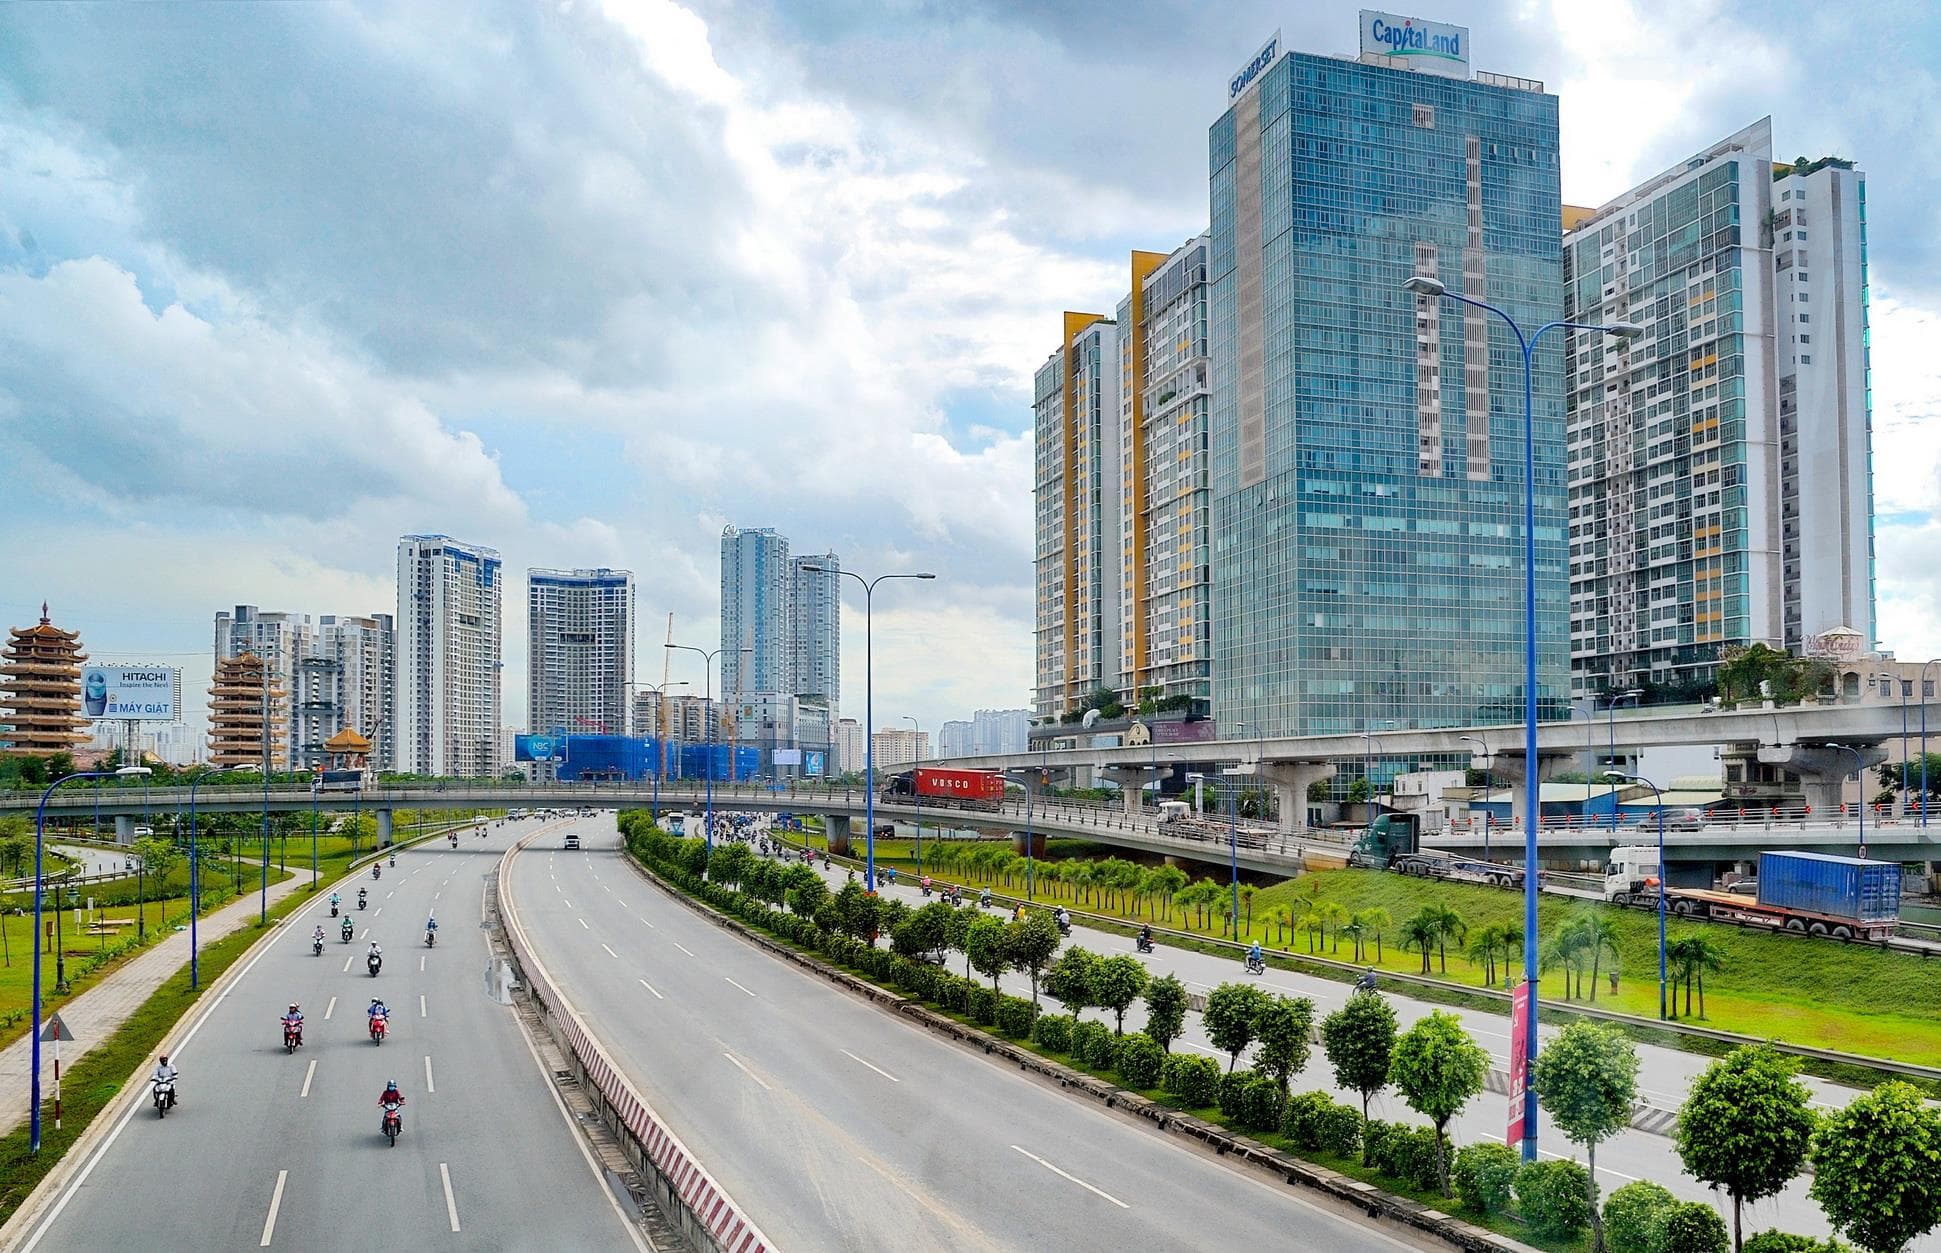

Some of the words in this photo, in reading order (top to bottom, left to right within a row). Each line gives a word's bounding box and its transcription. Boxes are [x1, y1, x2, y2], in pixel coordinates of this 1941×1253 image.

[1372, 18, 1460, 55] CapitaLand
[1230, 38, 1277, 98] SOMERSET
[122, 672, 166, 681] HITACHI
[119, 701, 142, 713] MÁY
[932, 778, 969, 789] VOSCO
